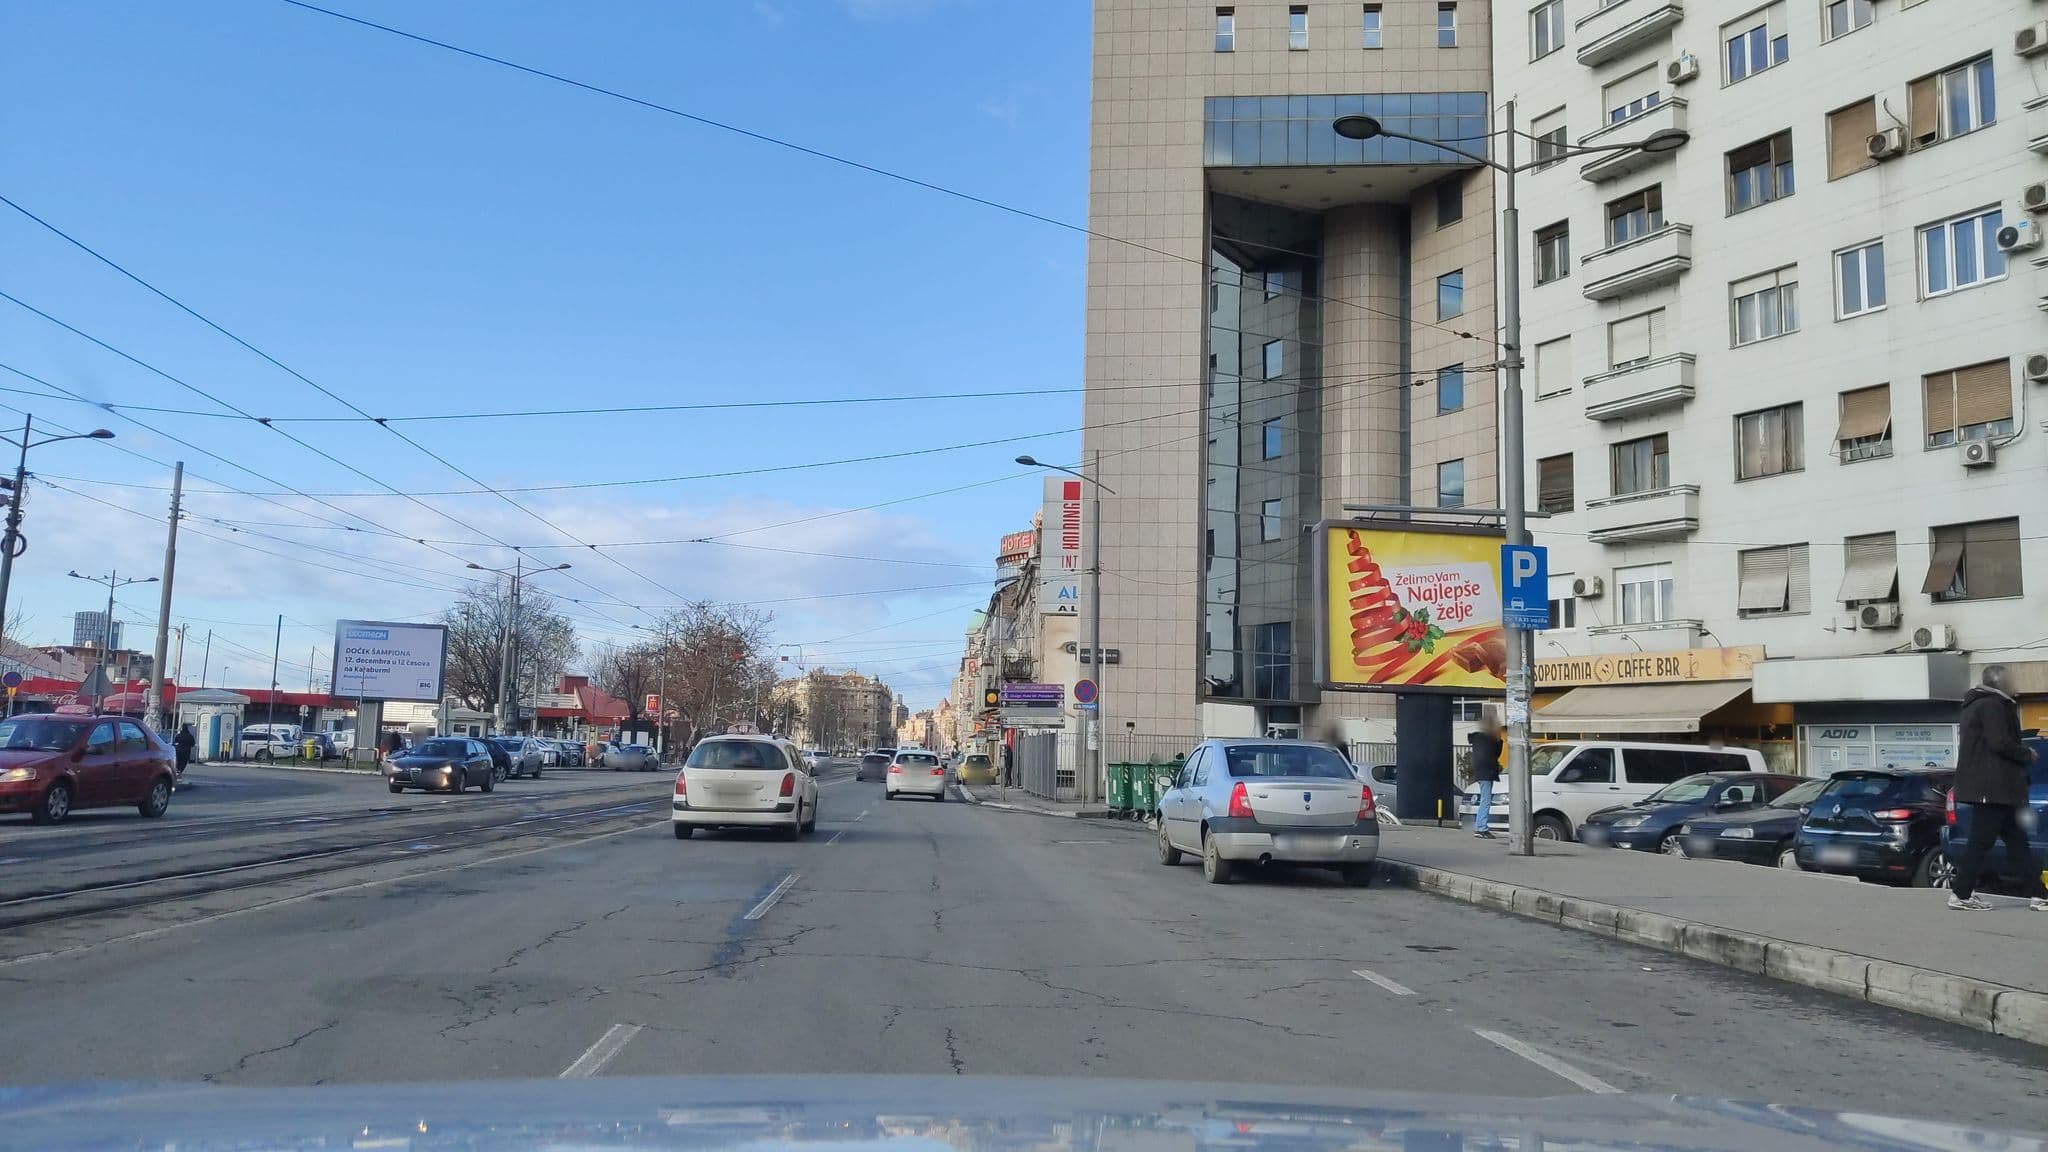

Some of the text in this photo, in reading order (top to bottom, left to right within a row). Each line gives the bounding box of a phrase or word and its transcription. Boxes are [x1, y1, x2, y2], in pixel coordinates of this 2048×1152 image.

[1061, 555, 1079, 568] INT
[1512, 550, 1537, 588] P
[1395, 571, 1461, 586] Želimo Vam
[1058, 586, 1079, 599] AL
[1407, 579, 1481, 604] Najlepše
[1436, 601, 1474, 622] želje
[345, 647, 411, 657] DOČEK ŠAMPIONA
[356, 657, 391, 665] decembra
[1617, 659, 1652, 679] CAFFE
[1657, 657, 1681, 676] BAR
[1820, 729, 1859, 739] ADIO
